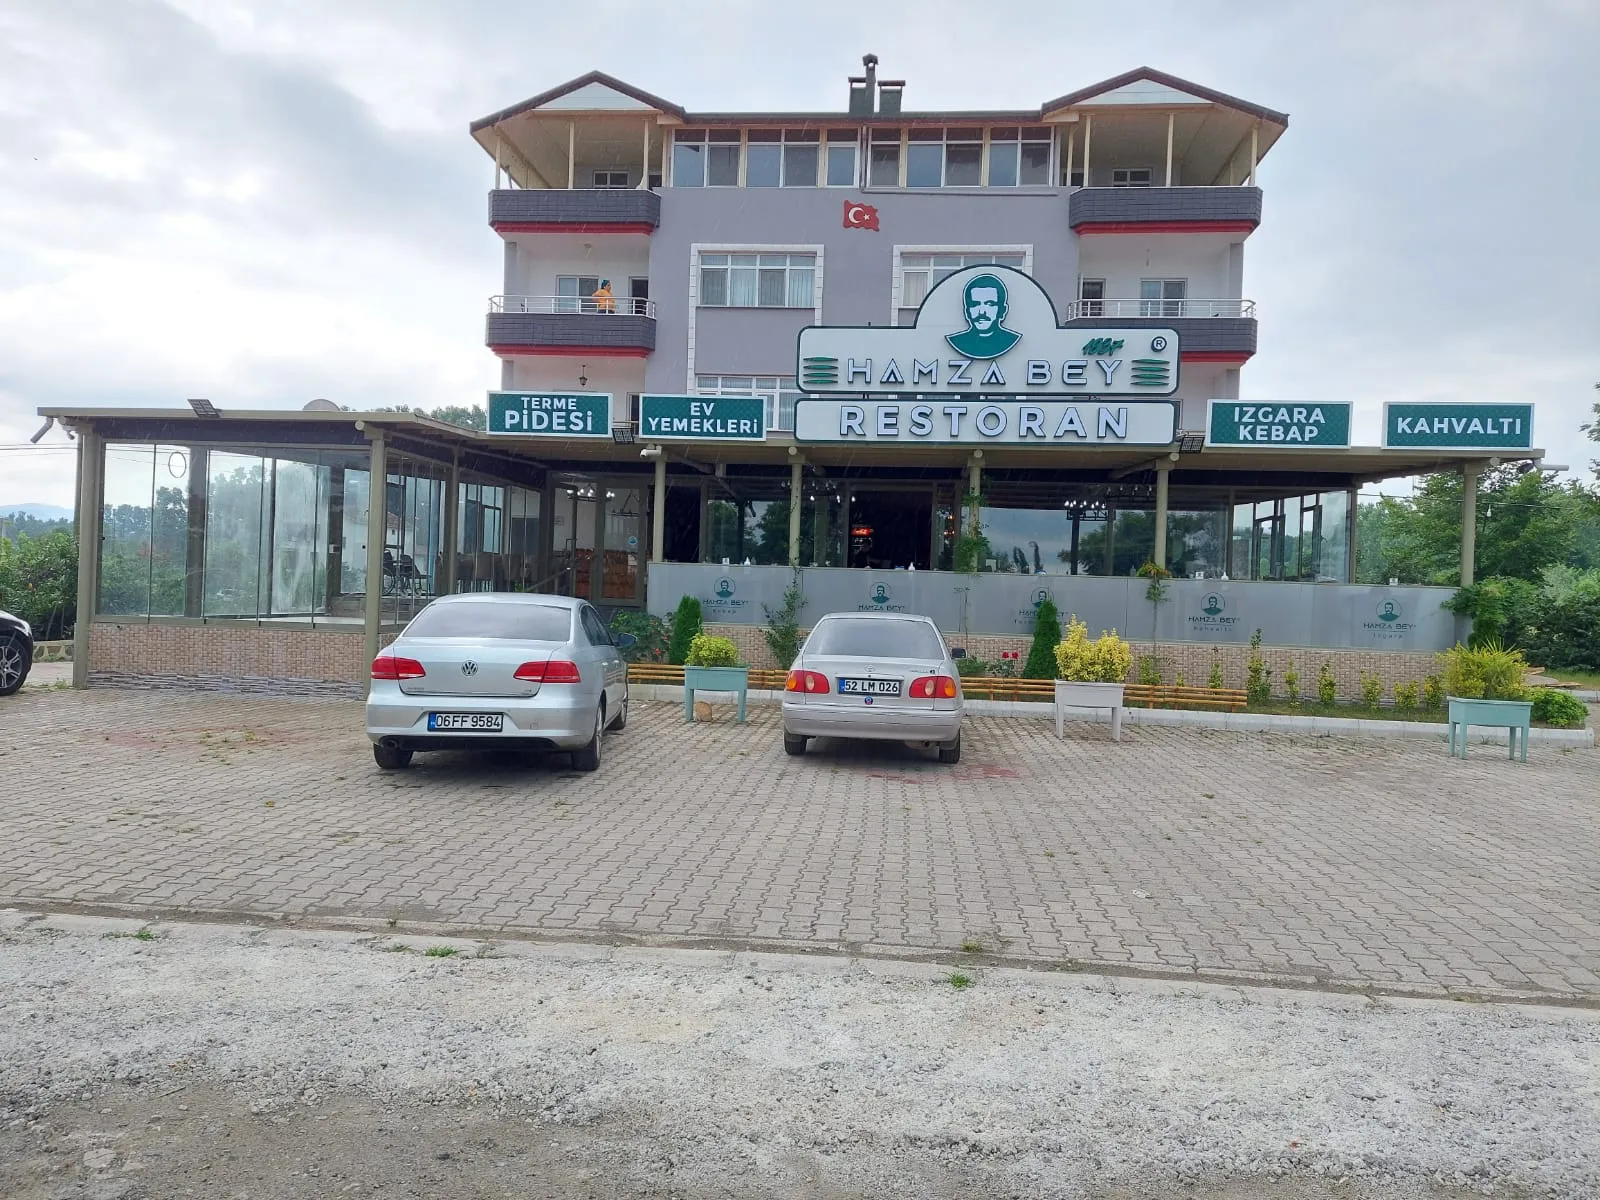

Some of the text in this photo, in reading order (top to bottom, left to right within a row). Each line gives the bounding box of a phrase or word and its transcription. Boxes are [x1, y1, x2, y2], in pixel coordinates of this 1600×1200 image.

[848, 358, 1122, 386] HAMZA BEY
[521, 396, 577, 410] TERME
[690, 402, 715, 416] EV
[839, 404, 1128, 439] RESTORAN
[1233, 406, 1326, 424] IZGARA
[1239, 425, 1319, 442] KEBAP
[1397, 417, 1521, 435] KAHVALTI
[845, 680, 898, 693] 52 LM 026
[436, 715, 450, 727] 06
[452, 715, 468, 727] FF
[471, 715, 501, 728] 9584
